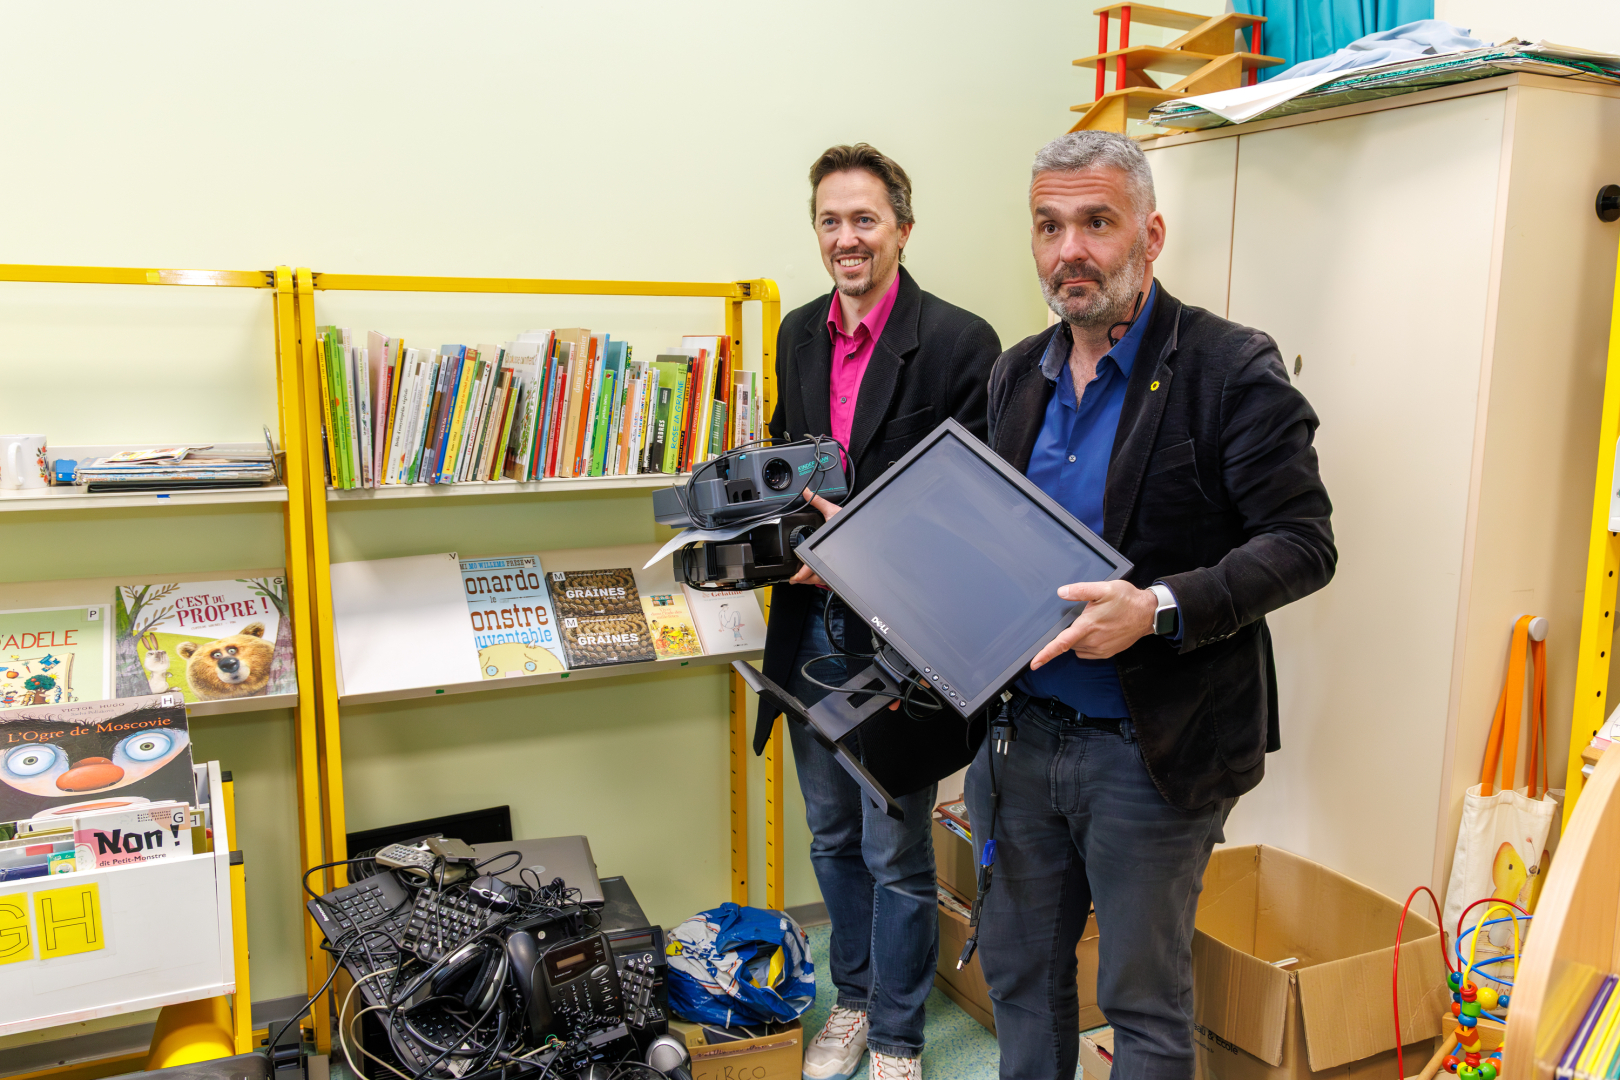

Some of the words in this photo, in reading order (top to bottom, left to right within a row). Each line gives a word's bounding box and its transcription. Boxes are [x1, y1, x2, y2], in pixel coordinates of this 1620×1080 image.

[572, 376, 581, 393] dans
[577, 334, 589, 357] panier
[673, 414, 679, 423] LA
[656, 419, 665, 443] ARBRES
[669, 425, 680, 449] ROSE
[465, 570, 539, 594] onardo
[566, 587, 626, 598] GRAINES
[175, 594, 210, 609] C'EST
[212, 595, 225, 604] DU
[176, 599, 257, 627] PROPRE
[261, 597, 269, 614] !
[471, 604, 548, 631] onstre
[871, 616, 889, 635] DELL
[0, 632, 78, 650] 'ADELE
[474, 627, 552, 648] uvantable
[578, 633, 639, 645] GRAINES
[8, 730, 64, 743] L'Ogre
[70, 726, 89, 737] de
[96, 717, 172, 733] Moscovie
[173, 812, 183, 823] G
[94, 829, 162, 855] Non
[170, 824, 180, 846] !
[113, 853, 166, 865] Petit-Monstre
[41, 891, 96, 950] H
